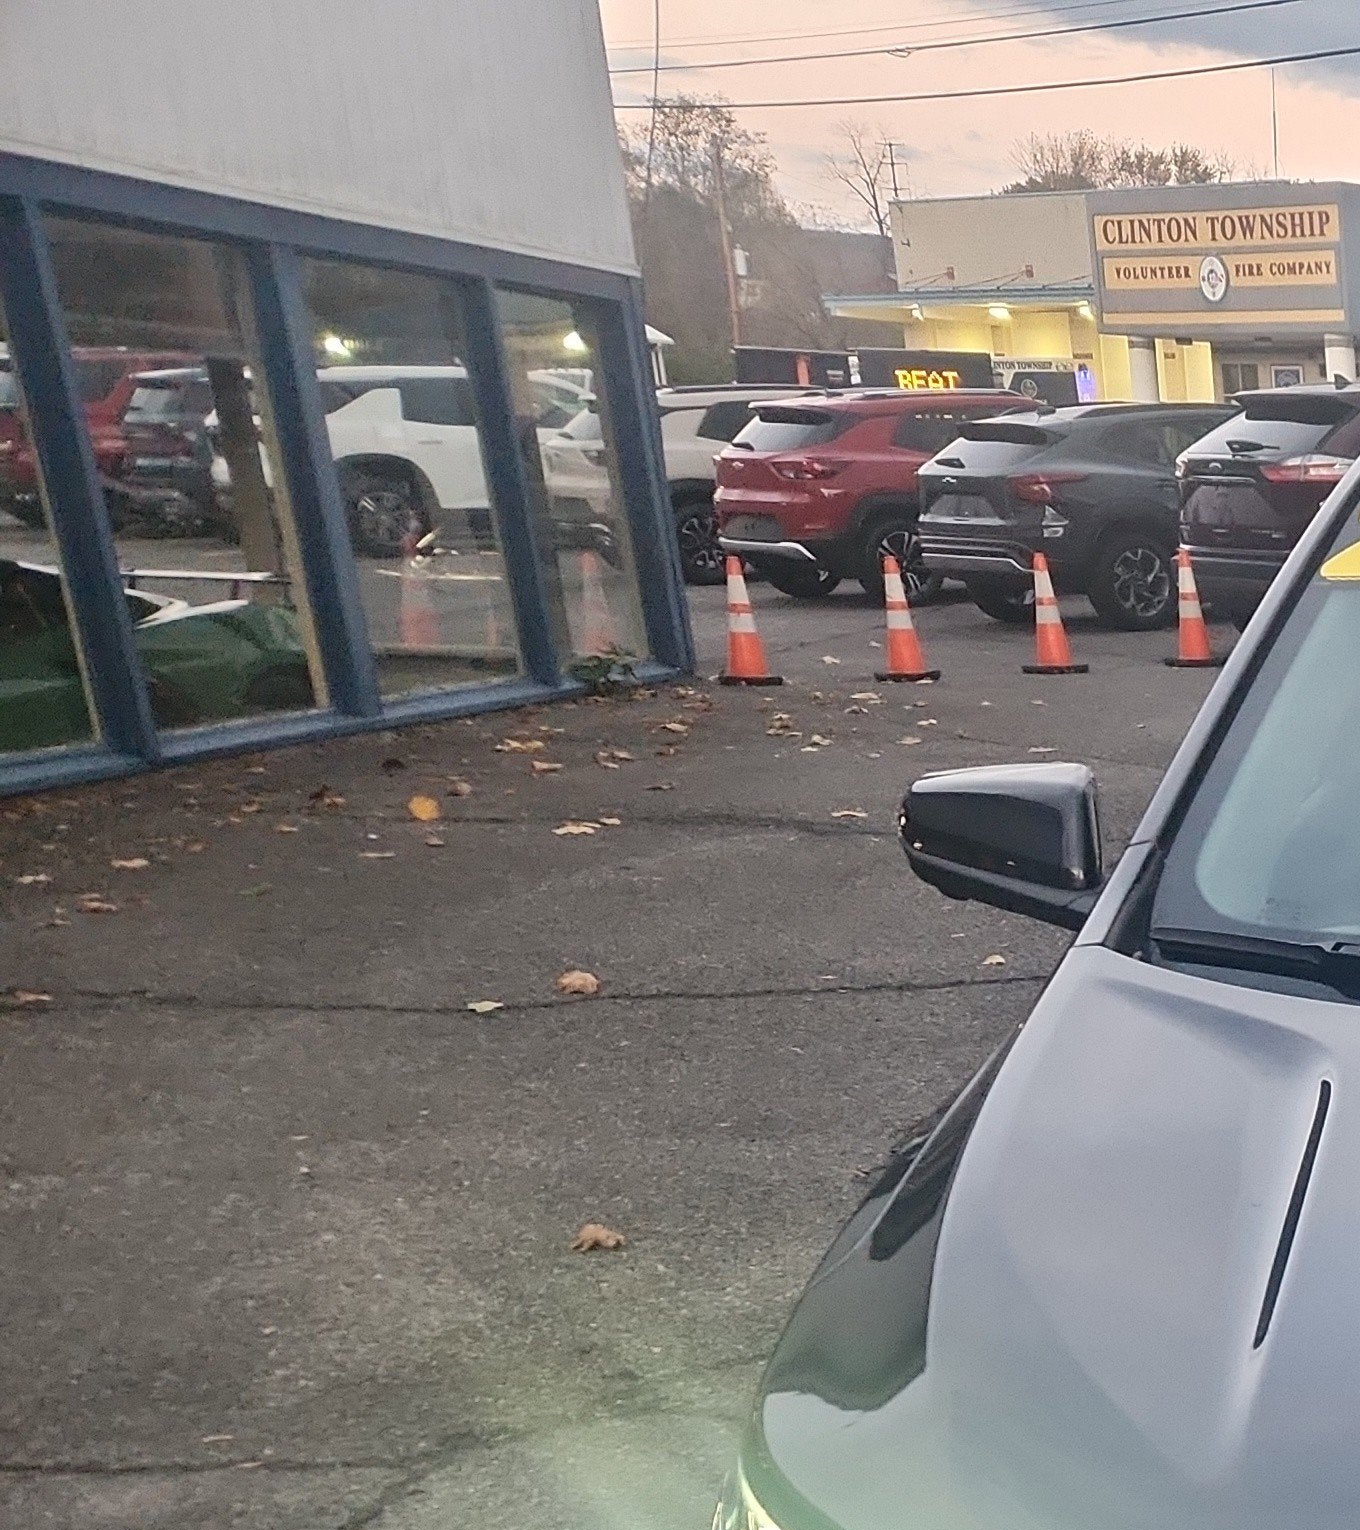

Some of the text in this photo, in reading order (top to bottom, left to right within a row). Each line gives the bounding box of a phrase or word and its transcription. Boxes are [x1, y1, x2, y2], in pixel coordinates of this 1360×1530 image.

[1102, 210, 1331, 245] CLINTON TOWNSHIP
[1115, 260, 1332, 280] VOLUNTEER FIRE COMPANY
[993, 361, 1053, 372] INTON TOWNSHIP
